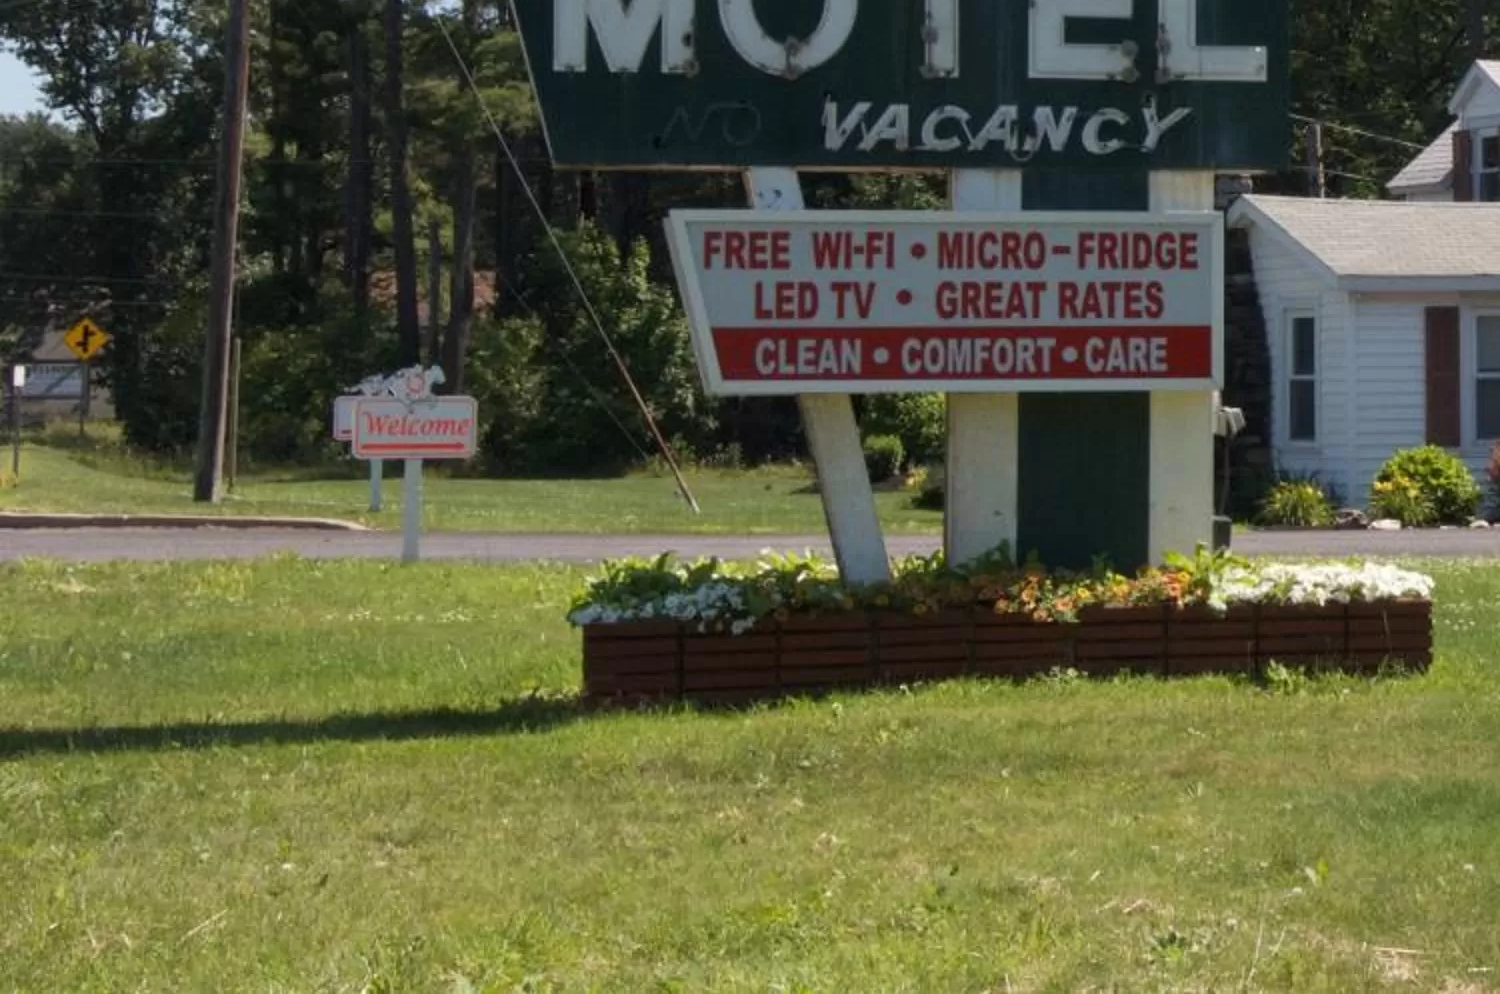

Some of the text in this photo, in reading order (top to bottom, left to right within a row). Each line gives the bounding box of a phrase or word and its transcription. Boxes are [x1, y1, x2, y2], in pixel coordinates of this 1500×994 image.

[823, 100, 1192, 155] VACANCY
[703, 231, 791, 269] FREE
[812, 231, 895, 269] WI-FI
[755, 281, 1165, 319] LED TV GREAT RATES
[755, 337, 1168, 374] CLEAN COMFORT CARE
[364, 411, 474, 437] Welcome
